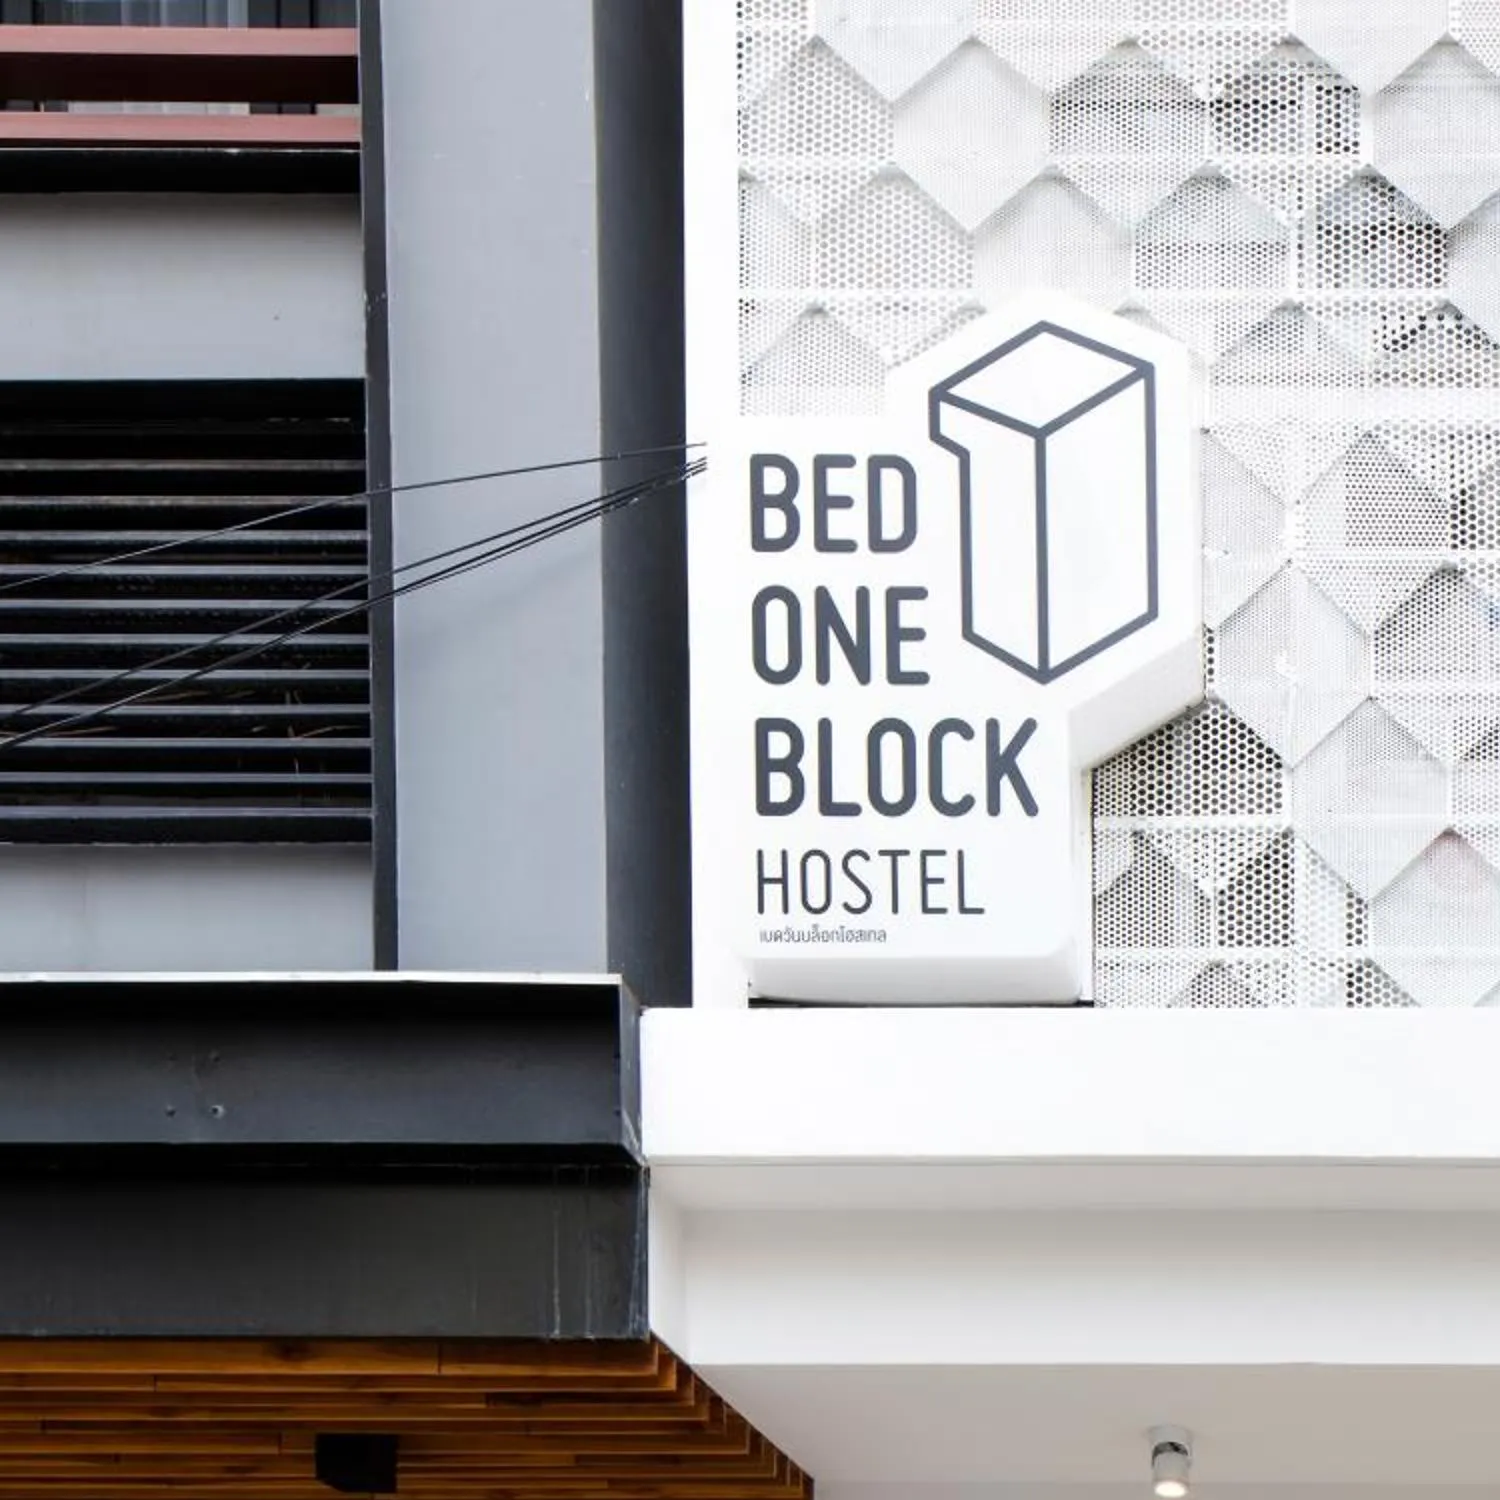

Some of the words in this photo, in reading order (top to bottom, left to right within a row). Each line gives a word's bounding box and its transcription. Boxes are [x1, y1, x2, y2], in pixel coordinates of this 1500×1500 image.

[749, 453, 918, 554] BED
[751, 584, 931, 687] ONE
[754, 717, 1039, 818] BLOCK
[756, 848, 985, 915] HOSTEL
